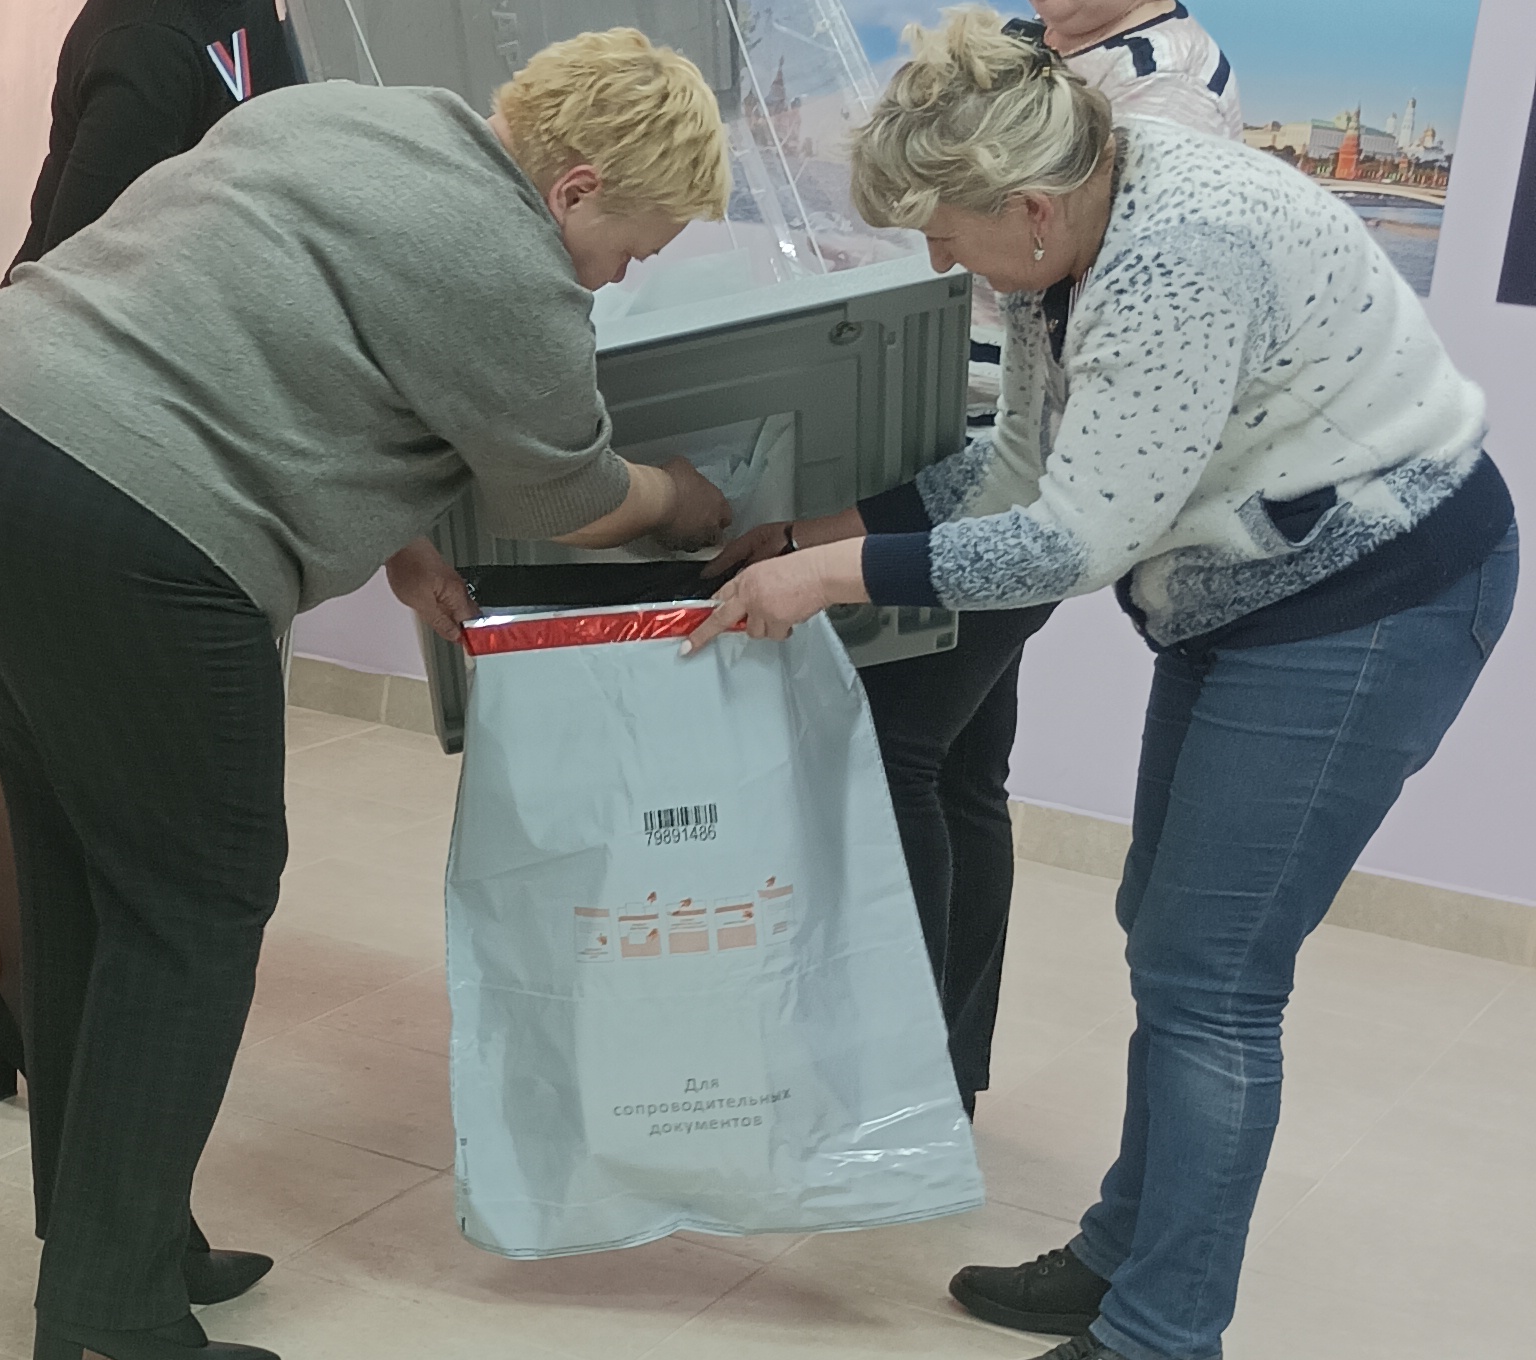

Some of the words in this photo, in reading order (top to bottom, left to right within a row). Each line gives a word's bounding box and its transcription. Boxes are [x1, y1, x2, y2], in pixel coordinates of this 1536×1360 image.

[644, 824, 717, 847] 79891486
[683, 1078, 720, 1093] Для
[613, 1087, 792, 1116] сопроводительных
[648, 1115, 763, 1137] документов
